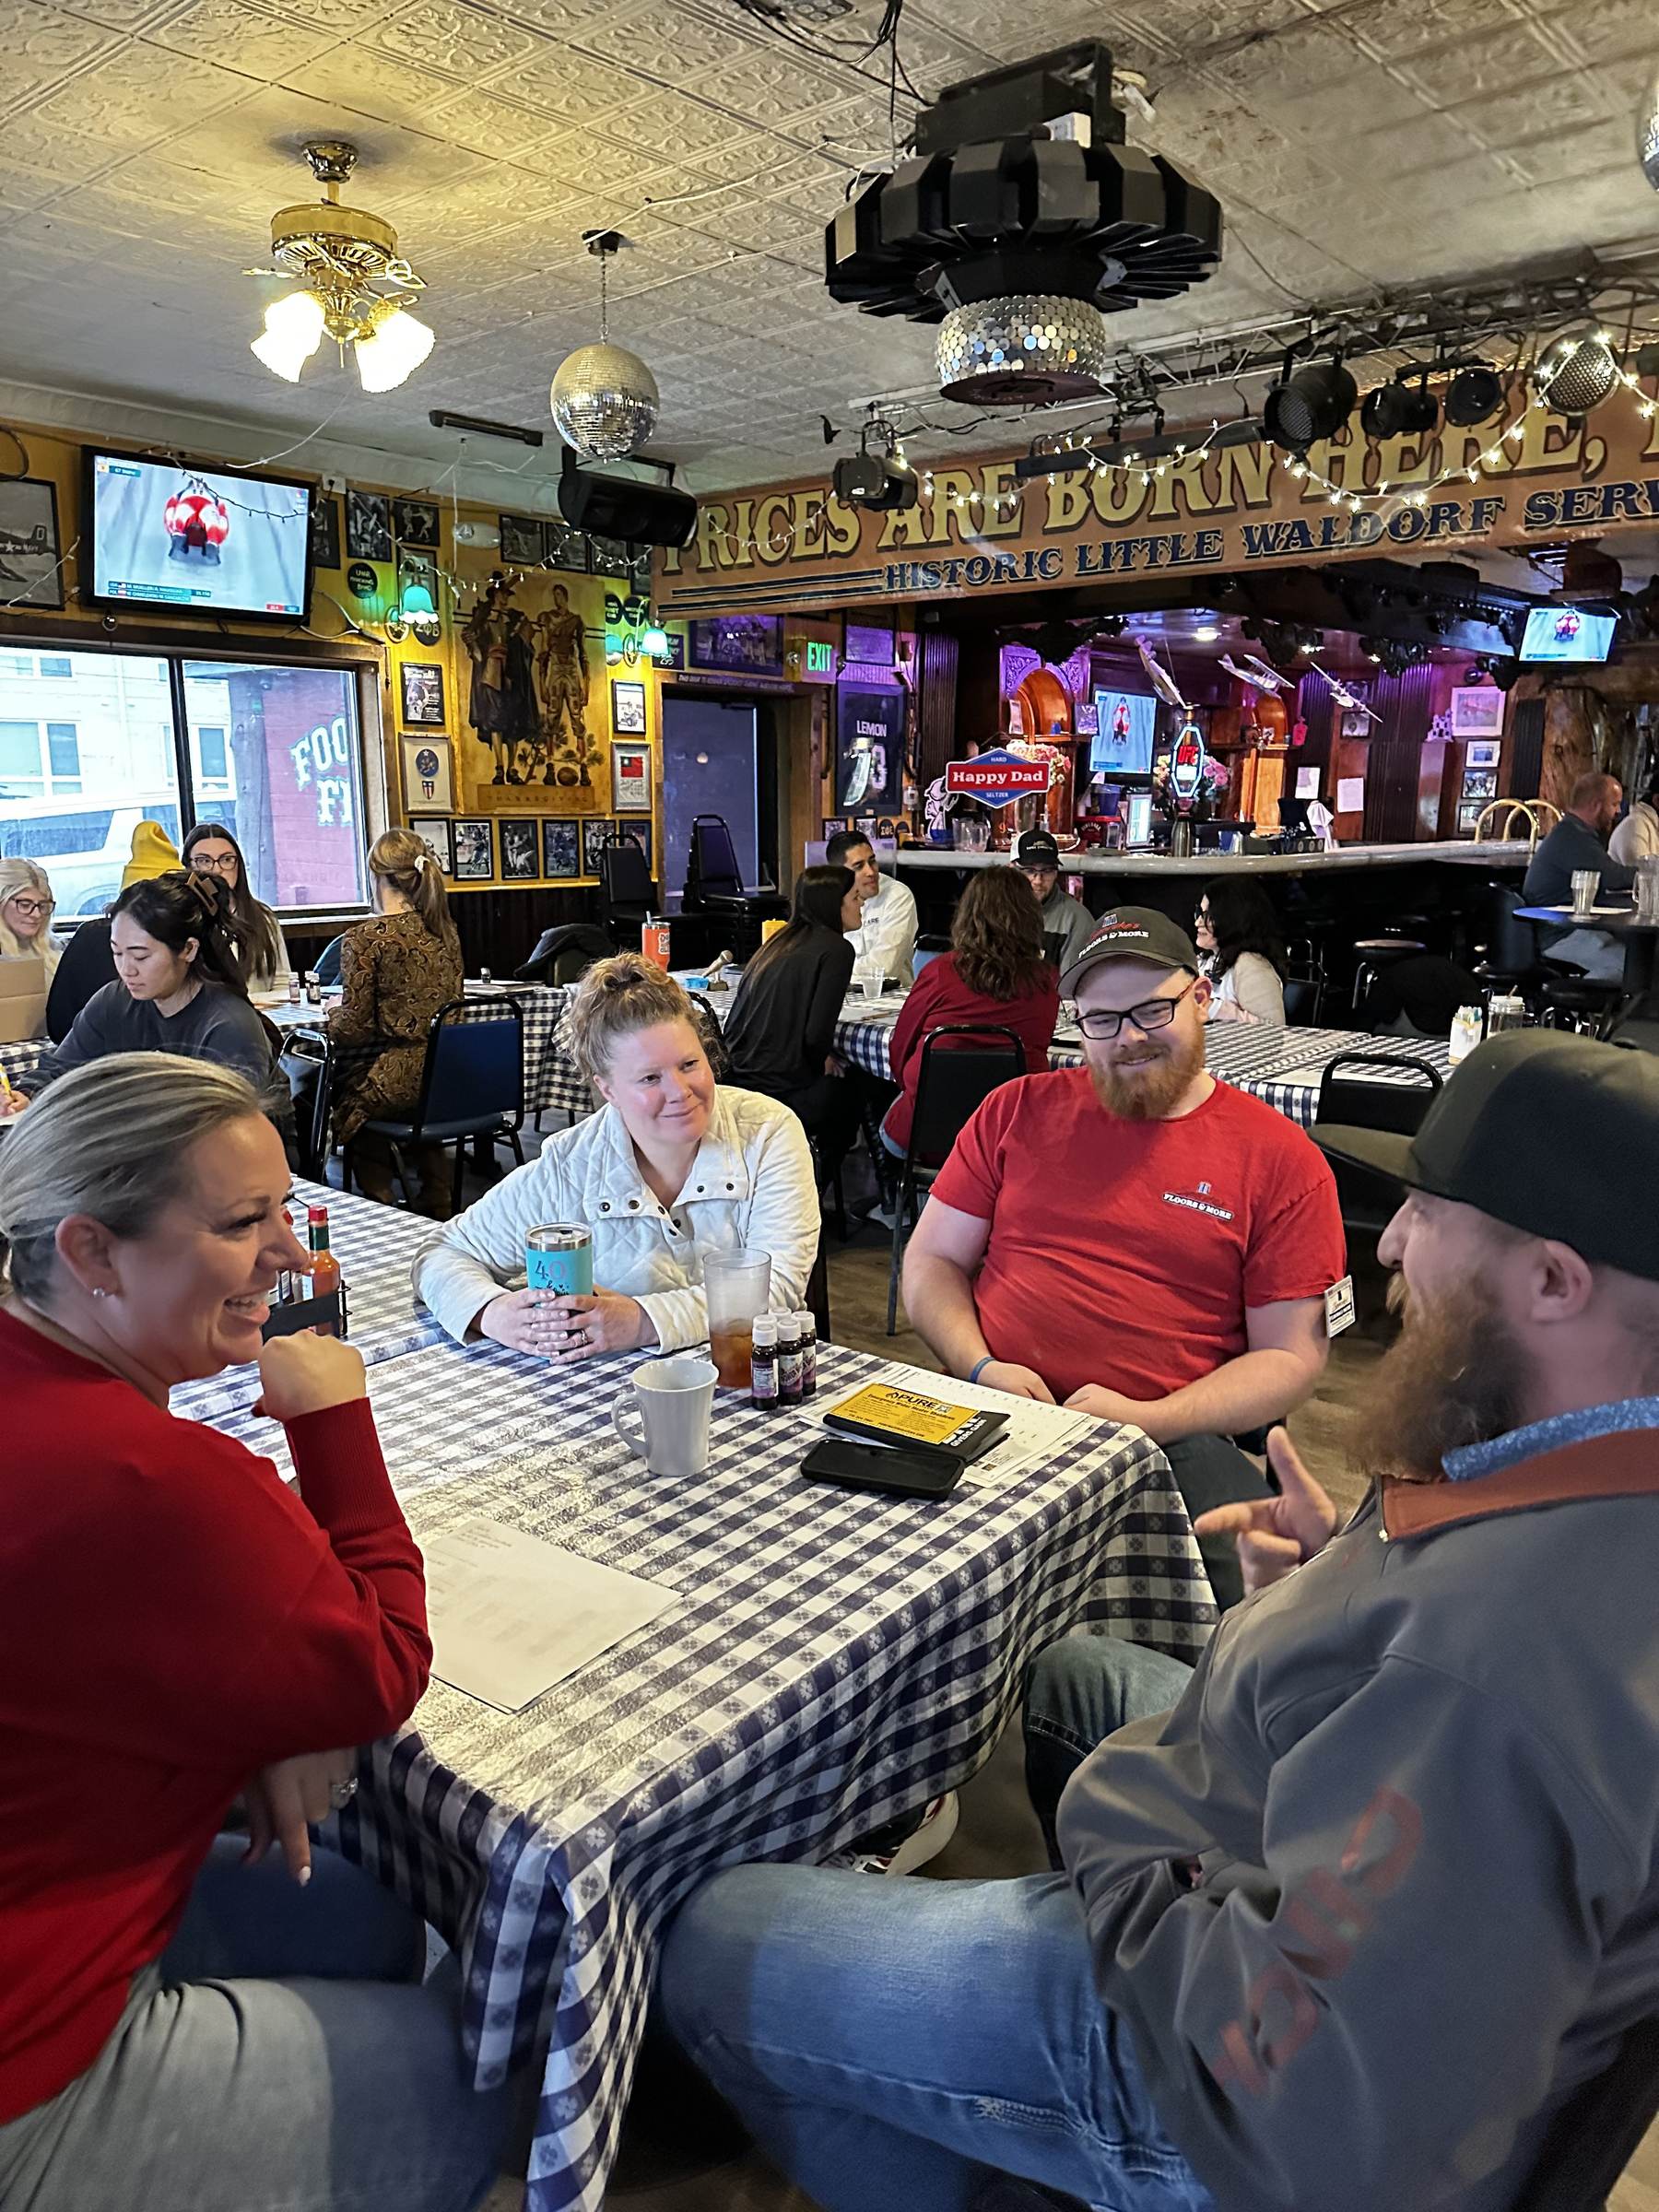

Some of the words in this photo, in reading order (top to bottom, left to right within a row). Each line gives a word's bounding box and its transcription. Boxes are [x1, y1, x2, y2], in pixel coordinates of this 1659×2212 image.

[1042, 439, 1274, 533] BORN
[884, 547, 1062, 593] HISTORIC
[1075, 528, 1224, 576] LITTLE
[1241, 495, 1506, 559] WALDORF
[807, 642, 833, 672] EXIT
[856, 720, 887, 737] LEMON
[953, 771, 1008, 784] Happy
[1010, 771, 1043, 782] Dad
[1117, 930, 1149, 938] MORE
[1163, 1193, 1199, 1208] FLOORS
[1206, 1205, 1232, 1219] MORE
[896, 1394, 939, 1408] PURE
